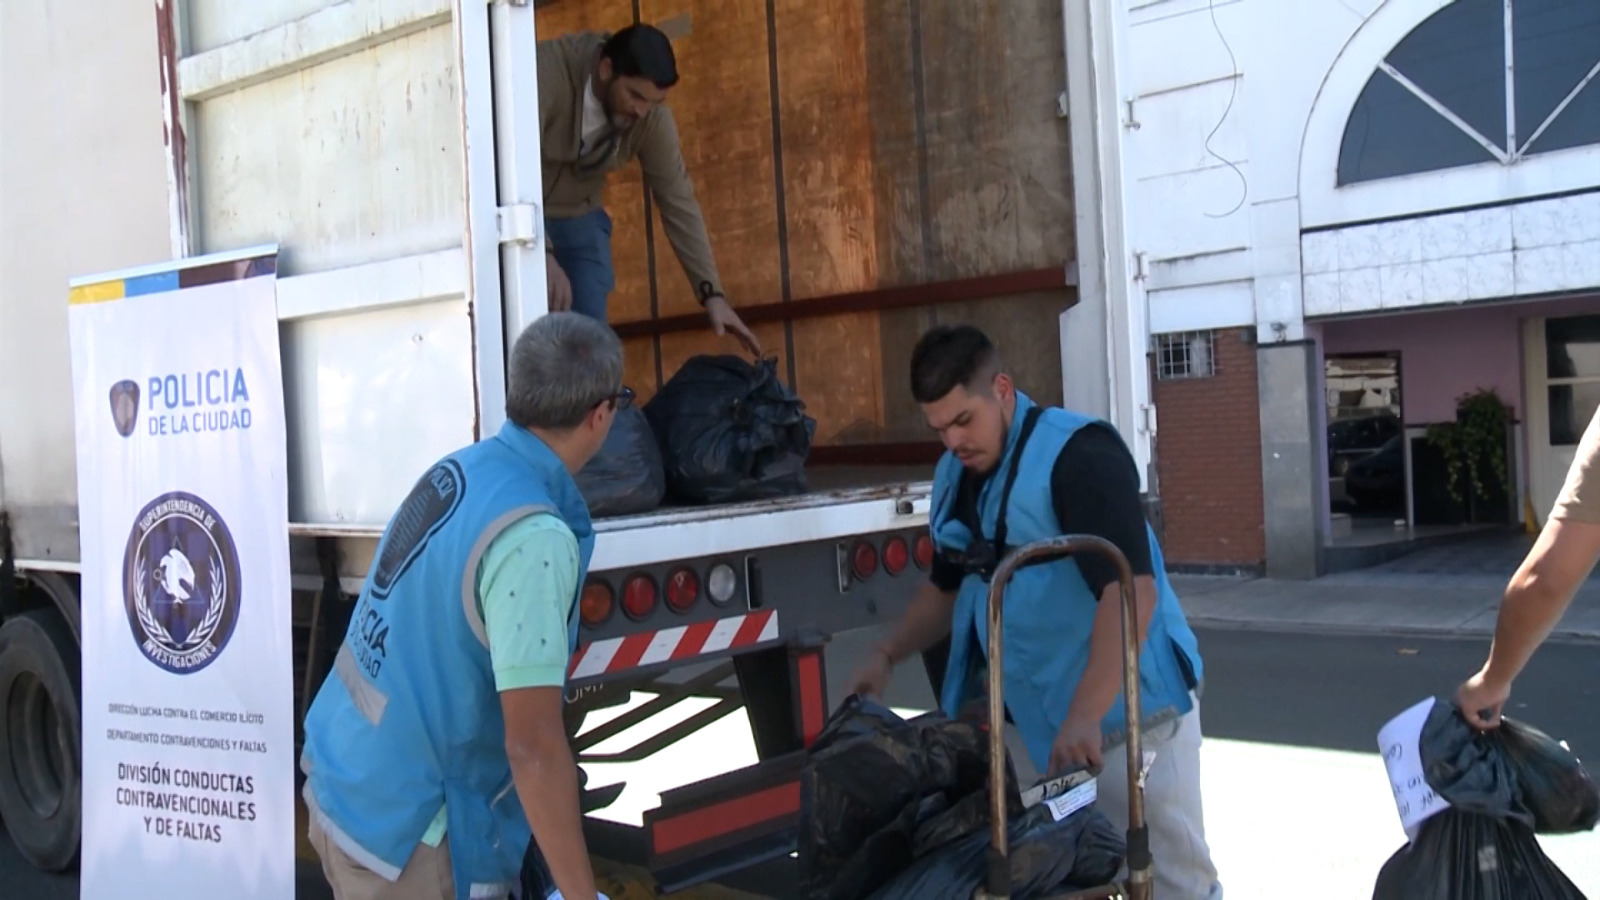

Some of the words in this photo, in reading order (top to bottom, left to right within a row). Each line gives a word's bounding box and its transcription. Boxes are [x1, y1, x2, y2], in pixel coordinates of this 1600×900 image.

[148, 367, 250, 411] POLICIA
[148, 415, 168, 437] DE
[171, 413, 190, 435] LA
[192, 407, 252, 433] CIUDAD
[139, 499, 206, 532] SUPERINTENDENCIA
[204, 513, 217, 531] DE
[142, 638, 218, 669] INVESTIGACIONES
[139, 706, 162, 717] LUCHA
[163, 707, 189, 719] CONTRA
[189, 709, 199, 721] EL
[200, 710, 238, 724] COMERCIO
[106, 728, 159, 744] DEPARTAMENTO
[160, 733, 231, 751] CONTRAVENCIONES
[231, 740, 238, 750] Y
[239, 740, 267, 754] FALTAS
[117, 761, 171, 786] DIVISIÓN
[173, 768, 255, 795] CONDUCTAS
[115, 786, 257, 822] CONTRAVENCIONALES
[143, 816, 152, 833] Y
[155, 817, 173, 837] DE
[176, 820, 222, 844] FALTAS
